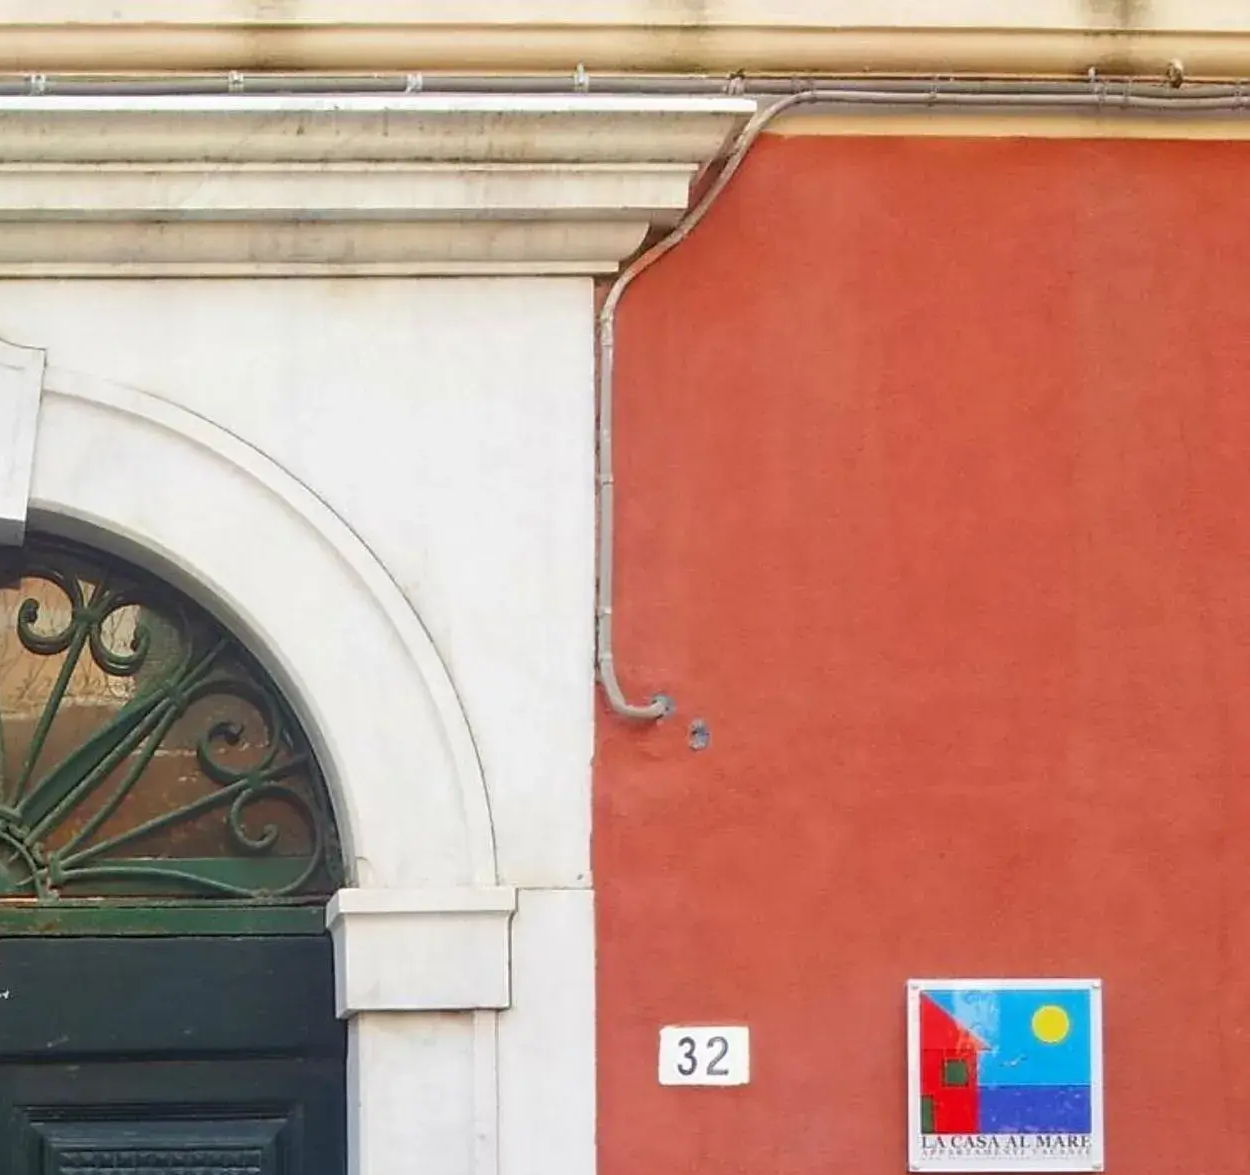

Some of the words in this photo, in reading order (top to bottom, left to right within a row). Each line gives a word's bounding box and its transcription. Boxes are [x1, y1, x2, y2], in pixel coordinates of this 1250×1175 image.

[677, 1036, 729, 1076] 32
[922, 1135, 946, 1149] LA
[951, 1135, 1000, 1149] CASA
[1007, 1135, 1032, 1149] AL
[1035, 1135, 1091, 1149] MARE
